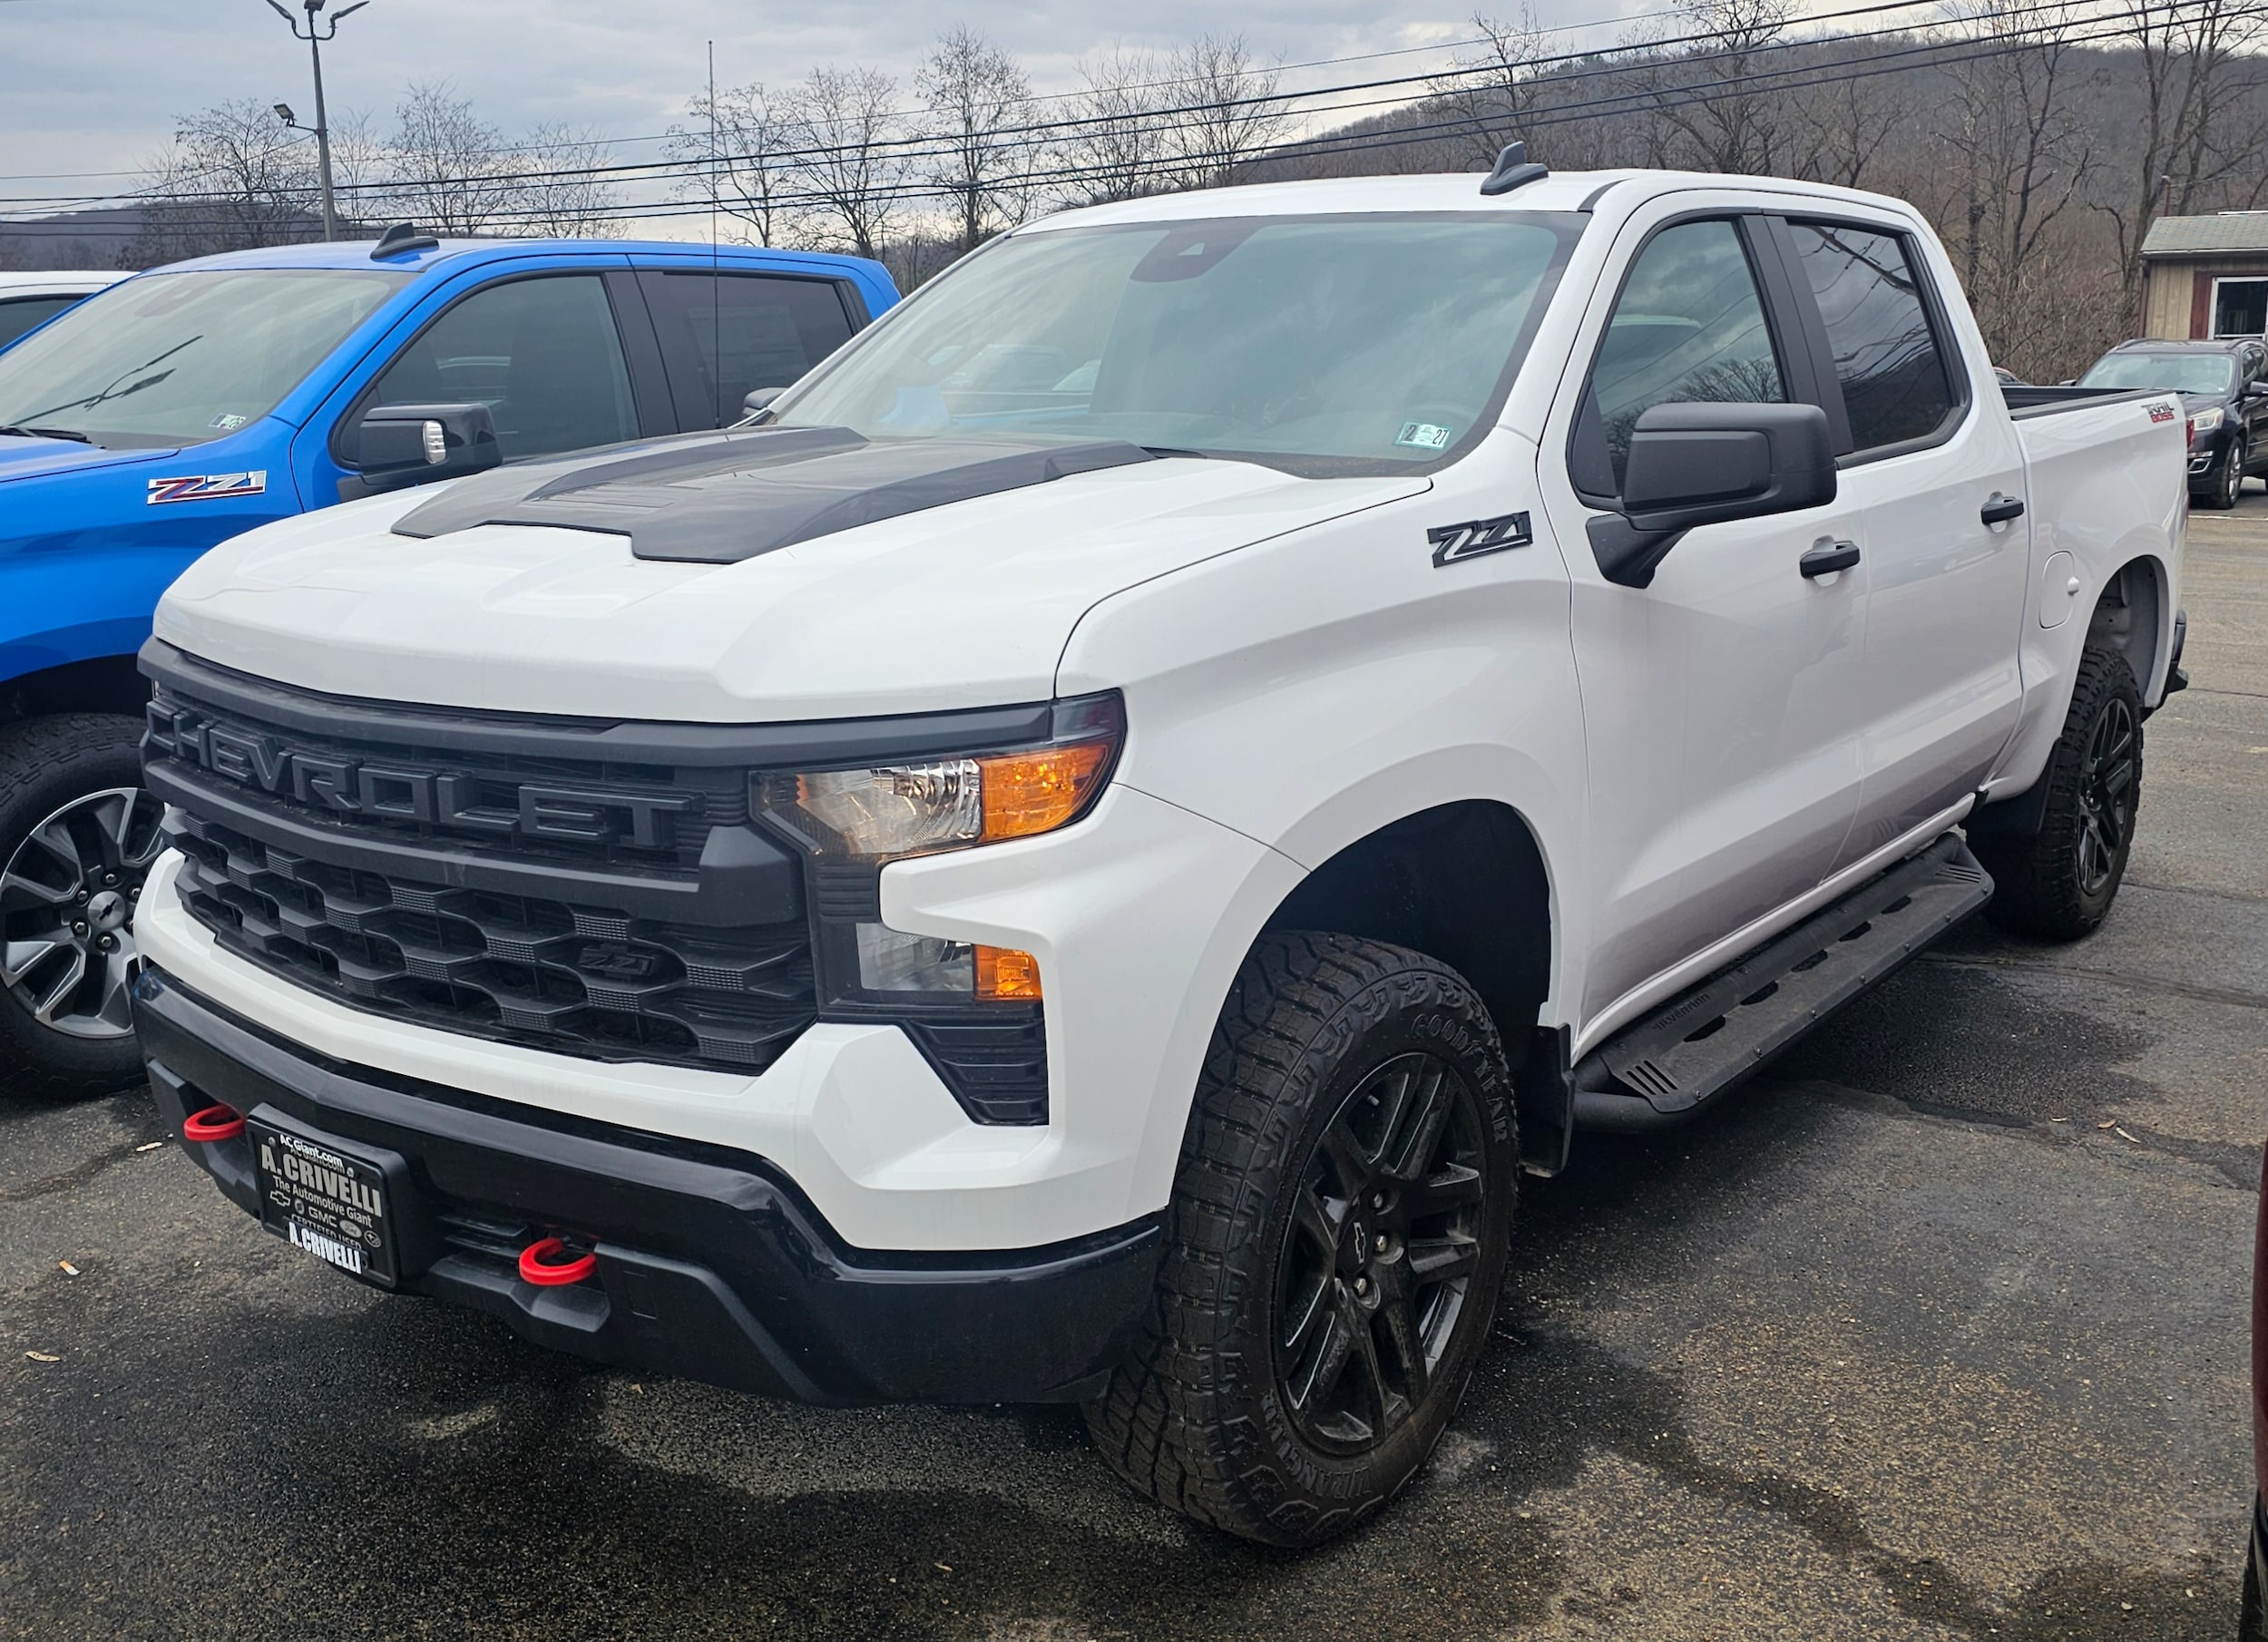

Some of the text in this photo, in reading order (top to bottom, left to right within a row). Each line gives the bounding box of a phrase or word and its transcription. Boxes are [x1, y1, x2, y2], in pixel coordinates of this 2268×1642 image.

[2141, 401, 2175, 415] TRAIL
[1432, 429, 1449, 445] 27
[146, 698, 707, 848] CHEVROLET
[1409, 1012, 1509, 1145] GOODYEAR
[272, 1175, 373, 1227] The Automotive Giant
[308, 1206, 337, 1228] GMC
